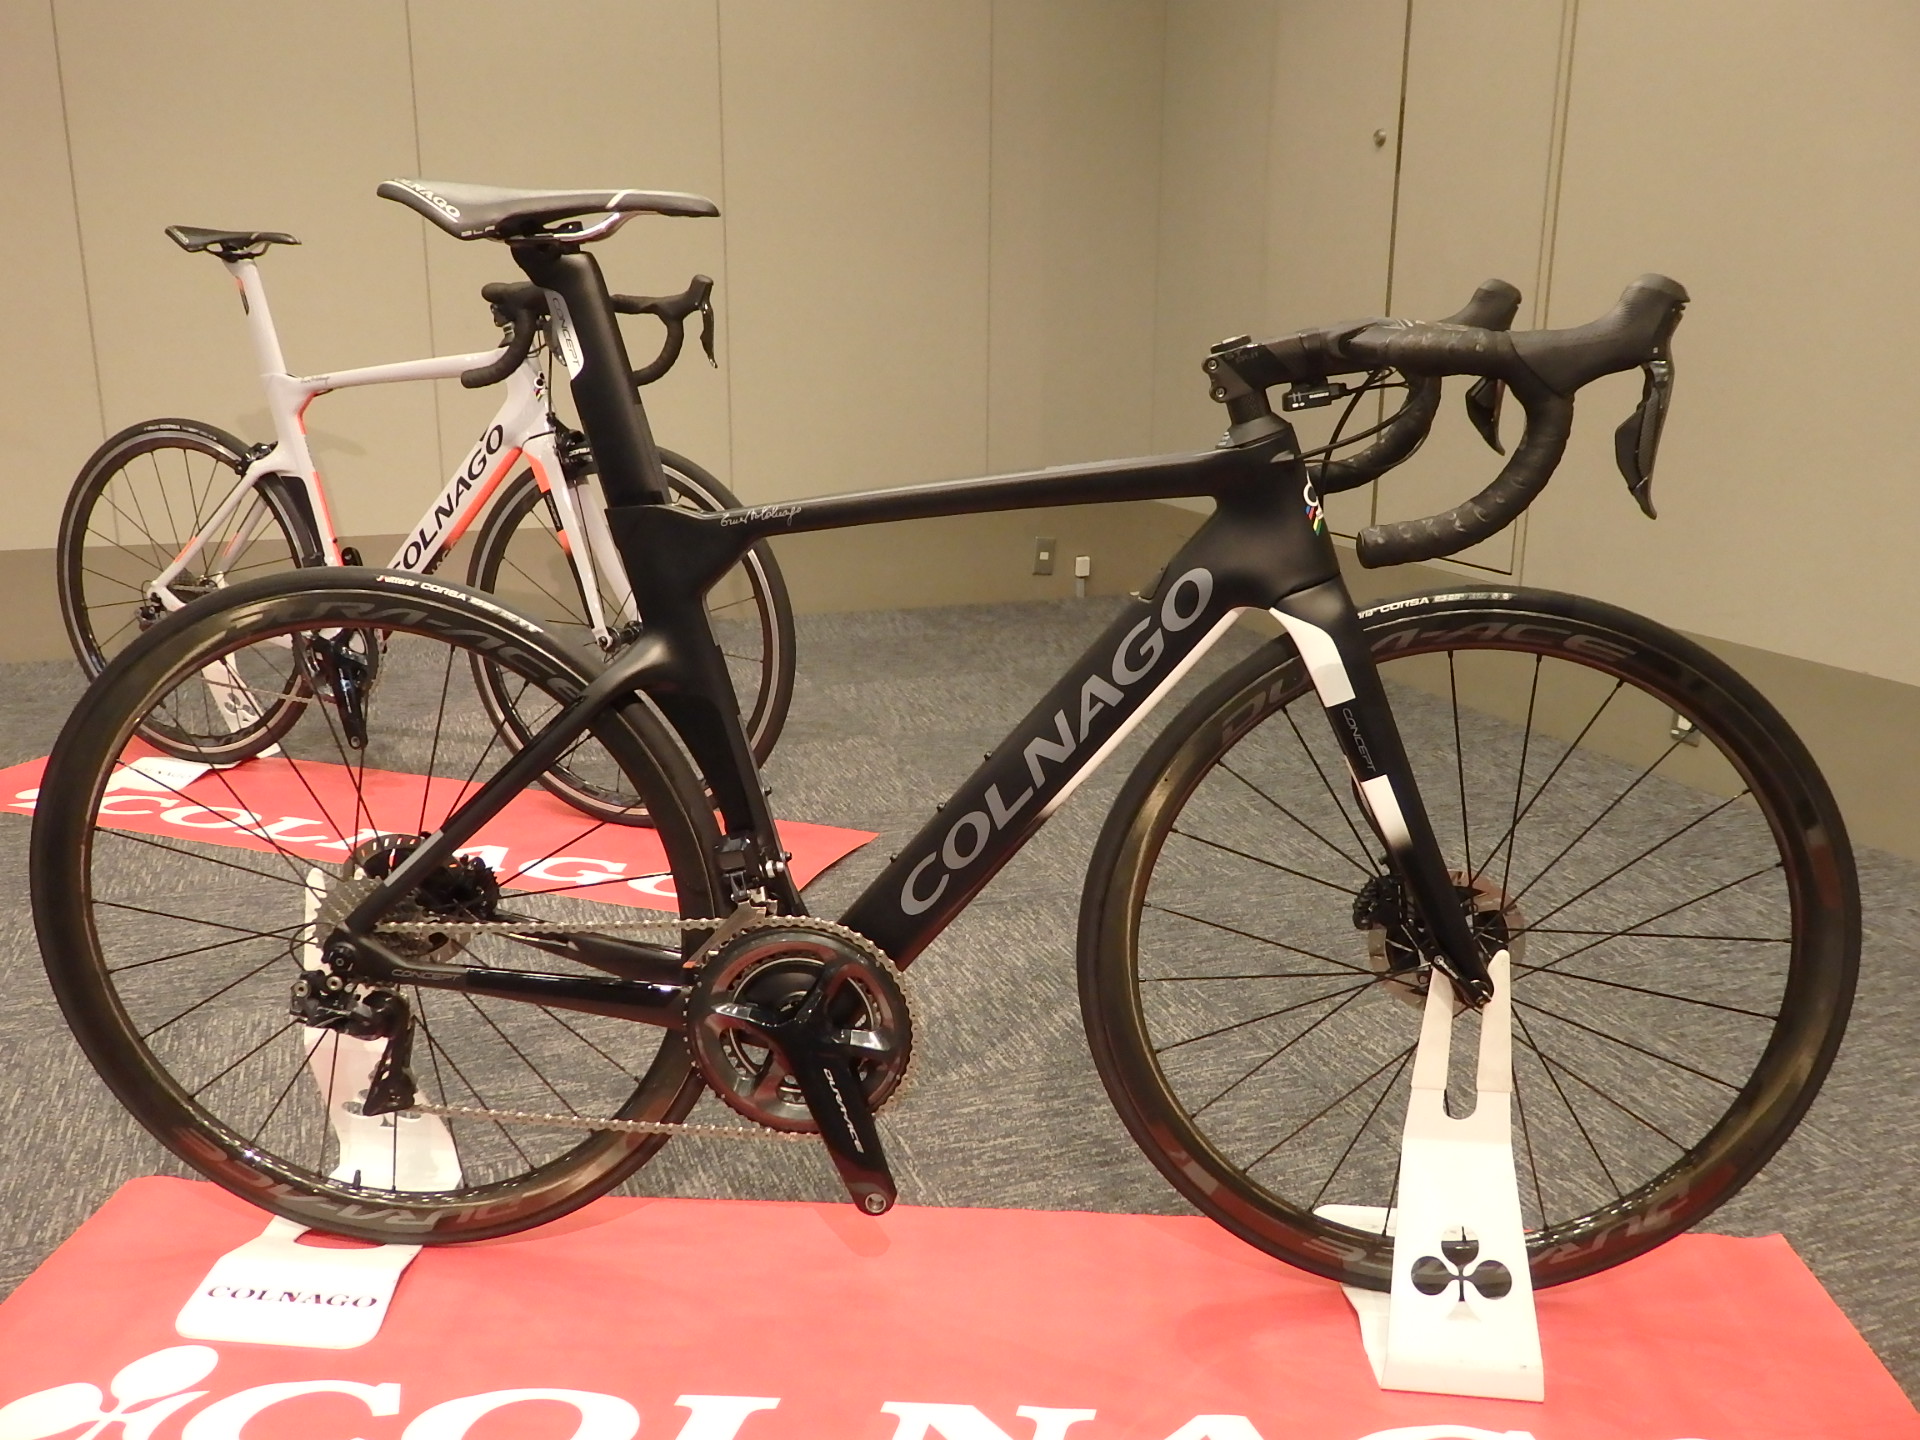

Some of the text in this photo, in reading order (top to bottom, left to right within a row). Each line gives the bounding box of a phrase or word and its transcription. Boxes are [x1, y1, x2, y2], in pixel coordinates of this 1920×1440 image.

[552, 297, 580, 368] CONCEPT
[393, 424, 504, 570] OLNAGO
[420, 582, 467, 601] CORSA
[1379, 596, 1430, 613] CORSA
[900, 567, 1214, 916] COLNAGO
[1342, 707, 1377, 772] CONCEPT
[391, 968, 462, 981] CONCEPT
[207, 1285, 378, 1308] COLNAGO
